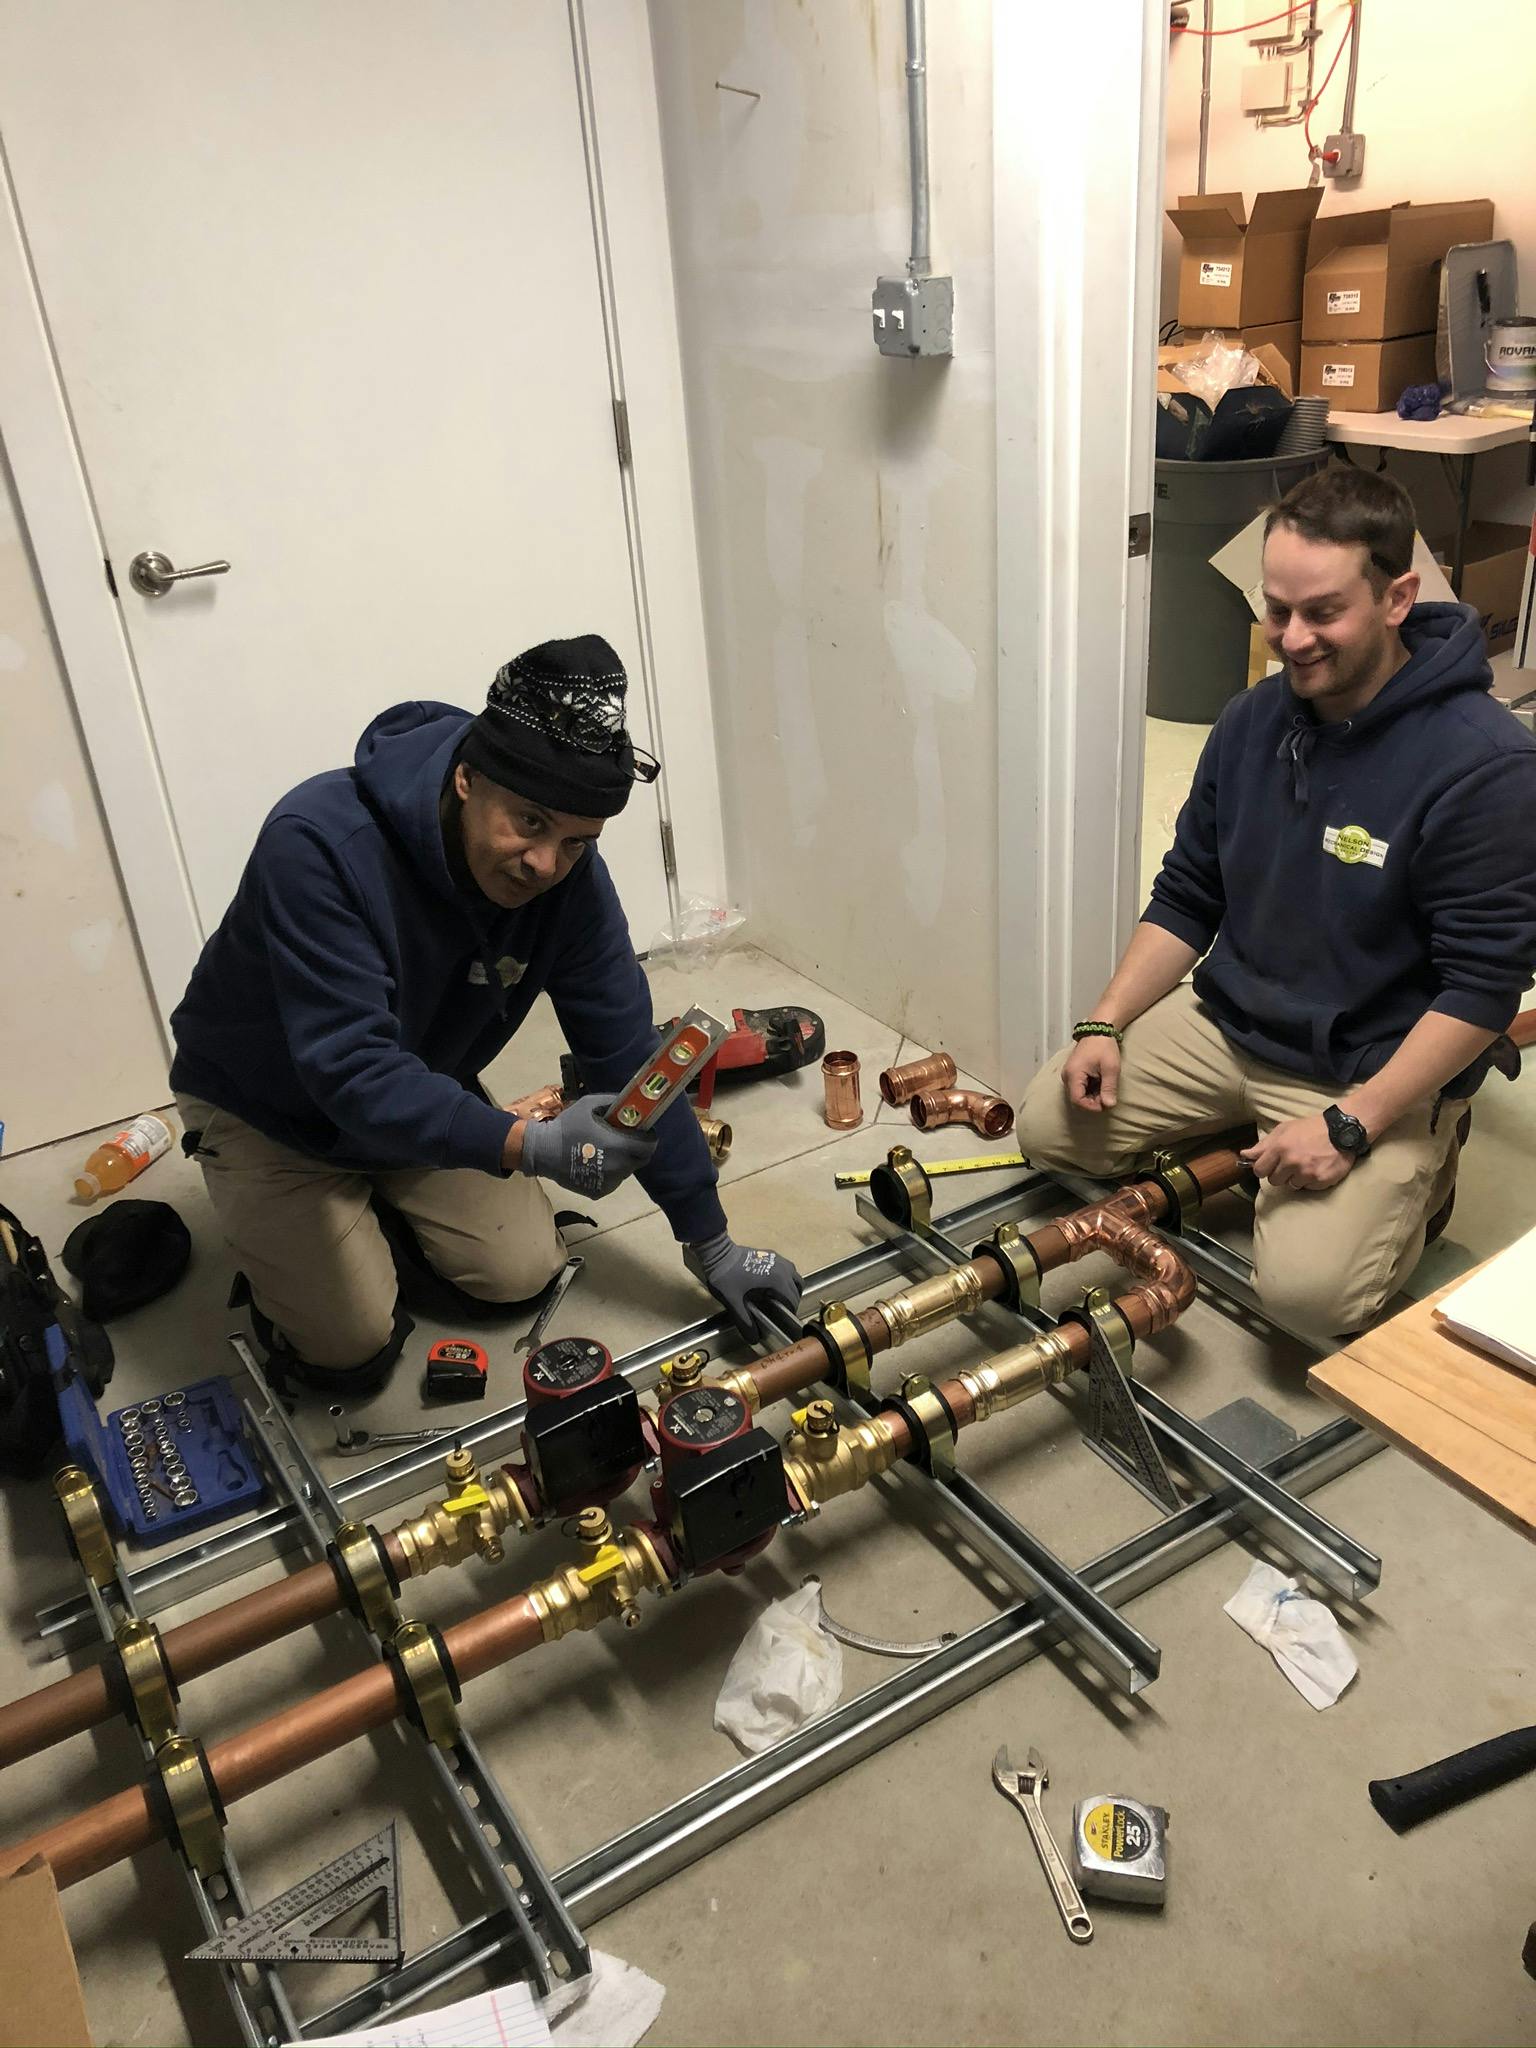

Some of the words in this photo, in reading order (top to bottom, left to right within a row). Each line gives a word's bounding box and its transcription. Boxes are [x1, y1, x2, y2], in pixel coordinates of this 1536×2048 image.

[1324, 837, 1358, 852] MECHANICAL
[1360, 847, 1384, 859] DESIGN
[1339, 834, 1369, 847] NELSON
[1101, 1812, 1110, 1850] STANLEY
